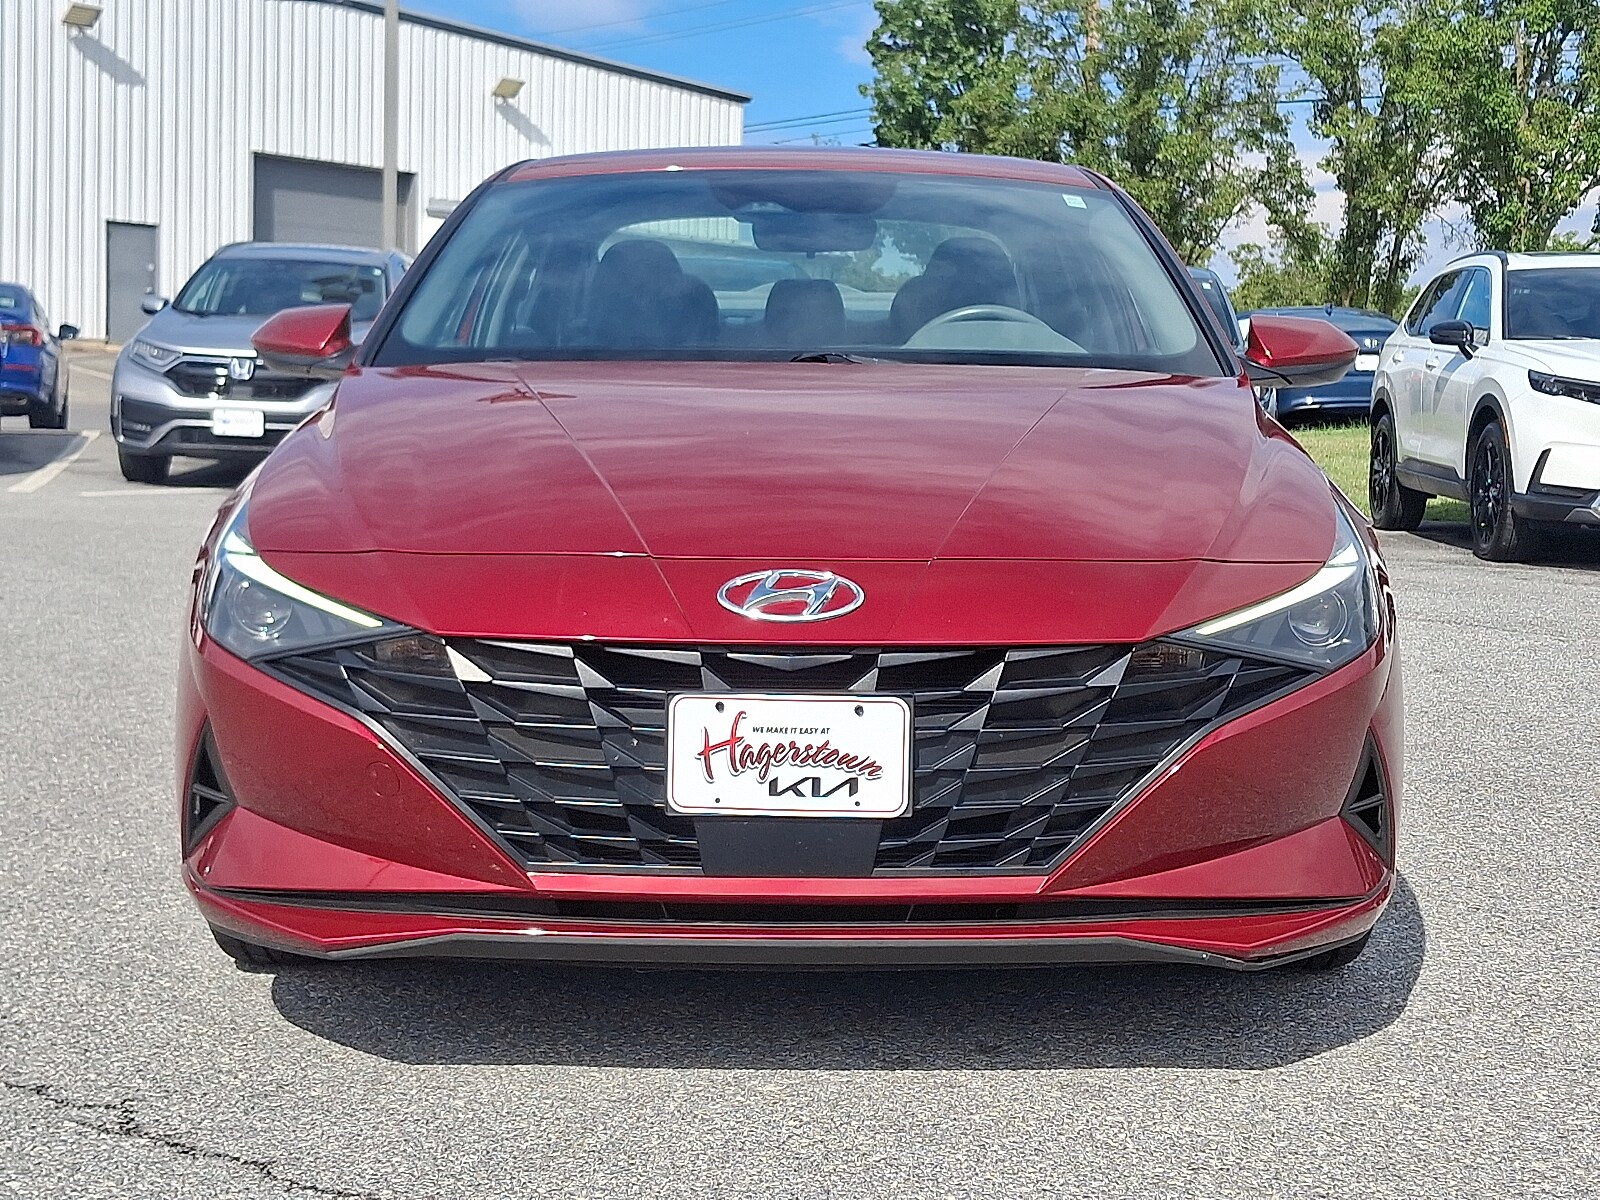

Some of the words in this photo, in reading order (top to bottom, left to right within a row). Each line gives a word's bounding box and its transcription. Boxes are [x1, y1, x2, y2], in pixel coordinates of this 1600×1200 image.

[752, 726, 765, 734] WE
[766, 726, 789, 735] MAKE
[790, 727, 798, 735] IT
[799, 727, 819, 735] EASY
[820, 727, 831, 735] AT
[696, 711, 883, 781] Hagerstown
[769, 776, 859, 798] KIA
